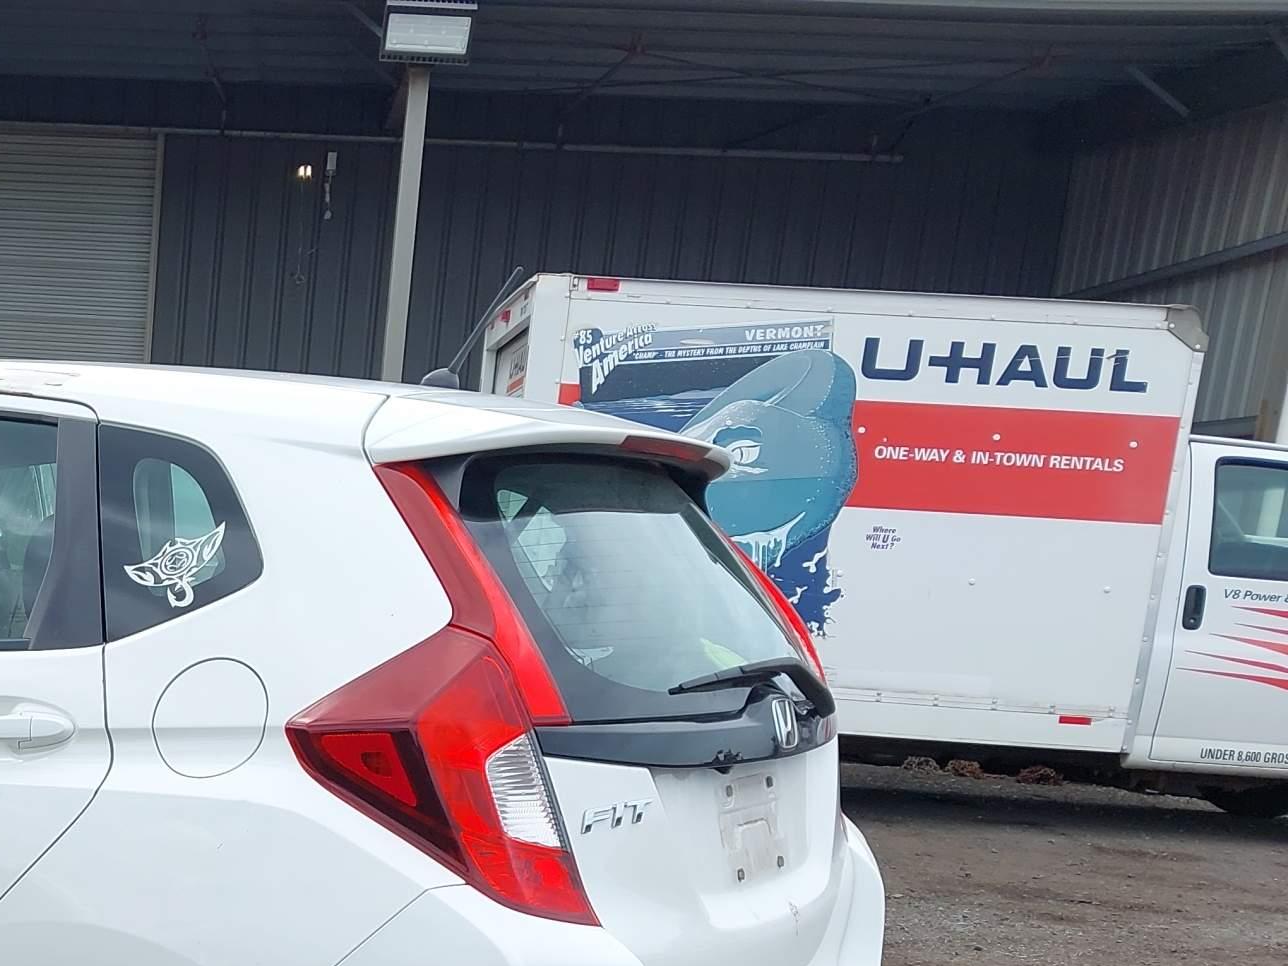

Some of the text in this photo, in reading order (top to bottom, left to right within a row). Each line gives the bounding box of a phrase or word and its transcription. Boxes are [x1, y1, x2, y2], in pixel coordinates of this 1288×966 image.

[745, 324, 825, 341] VERMONT
[575, 322, 657, 369] Venture Across
[664, 350, 675, 358] THE
[676, 348, 705, 357] MYSTERY
[706, 347, 725, 355] FROM
[725, 346, 737, 354] THE
[737, 345, 761, 353] DEPTHS
[762, 344, 772, 352] OF
[772, 343, 788, 351] LAKE
[592, 332, 653, 395] America
[861, 336, 1149, 393] U-HAUL
[874, 445, 1125, 472] ONE-WAY & IN-TOWN RENTALS
[865, 533, 881, 542] Will
[882, 534, 890, 543] U
[872, 526, 896, 534] Where
[1223, 588, 1241, 600] V8
[1243, 590, 1281, 602] Power
[1200, 747, 1235, 761] UNDER
[1237, 750, 1262, 763] 8,600
[580, 799, 654, 835] FIT
